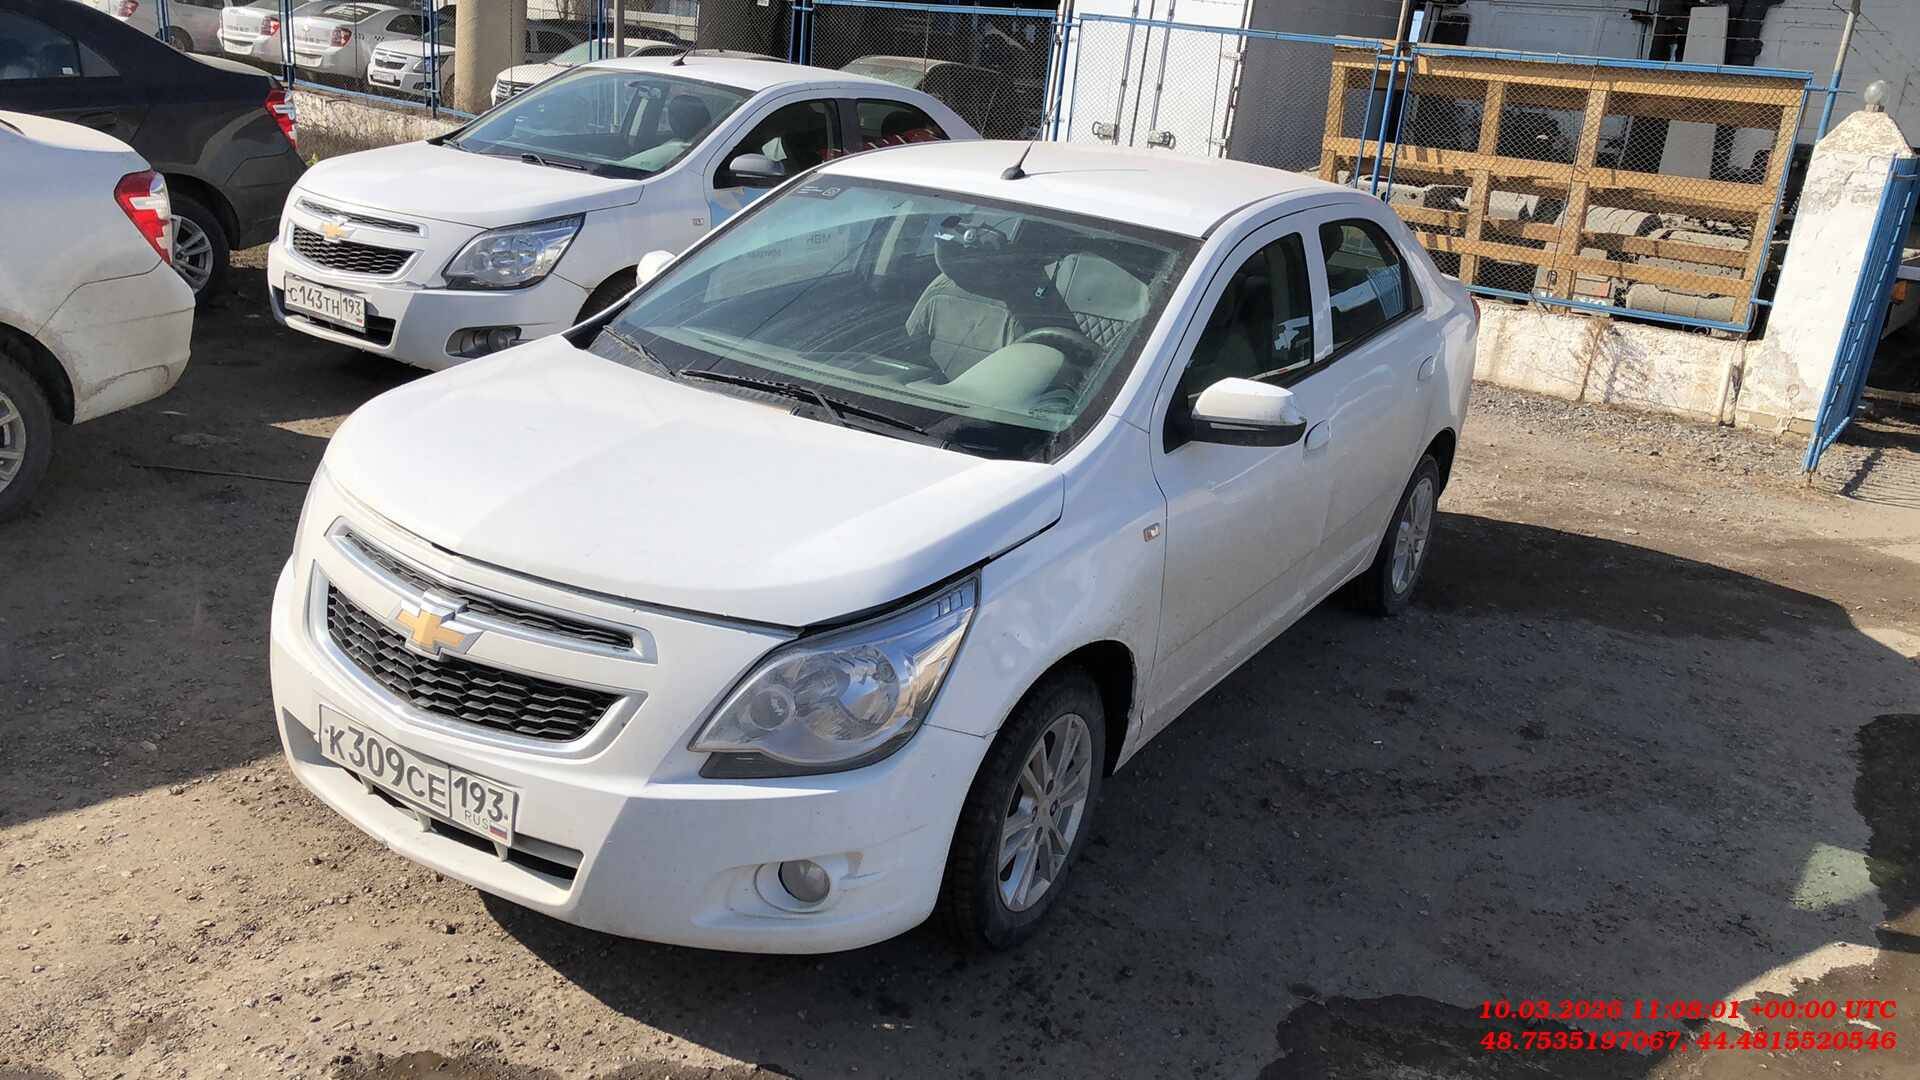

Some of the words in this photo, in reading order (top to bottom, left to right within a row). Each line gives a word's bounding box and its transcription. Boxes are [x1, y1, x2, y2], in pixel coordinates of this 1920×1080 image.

[290, 286, 339, 316] С143ТН
[343, 297, 361, 316] 193
[329, 725, 446, 810] К309СЕ
[453, 776, 504, 822] 193
[464, 809, 489, 830] RUS
